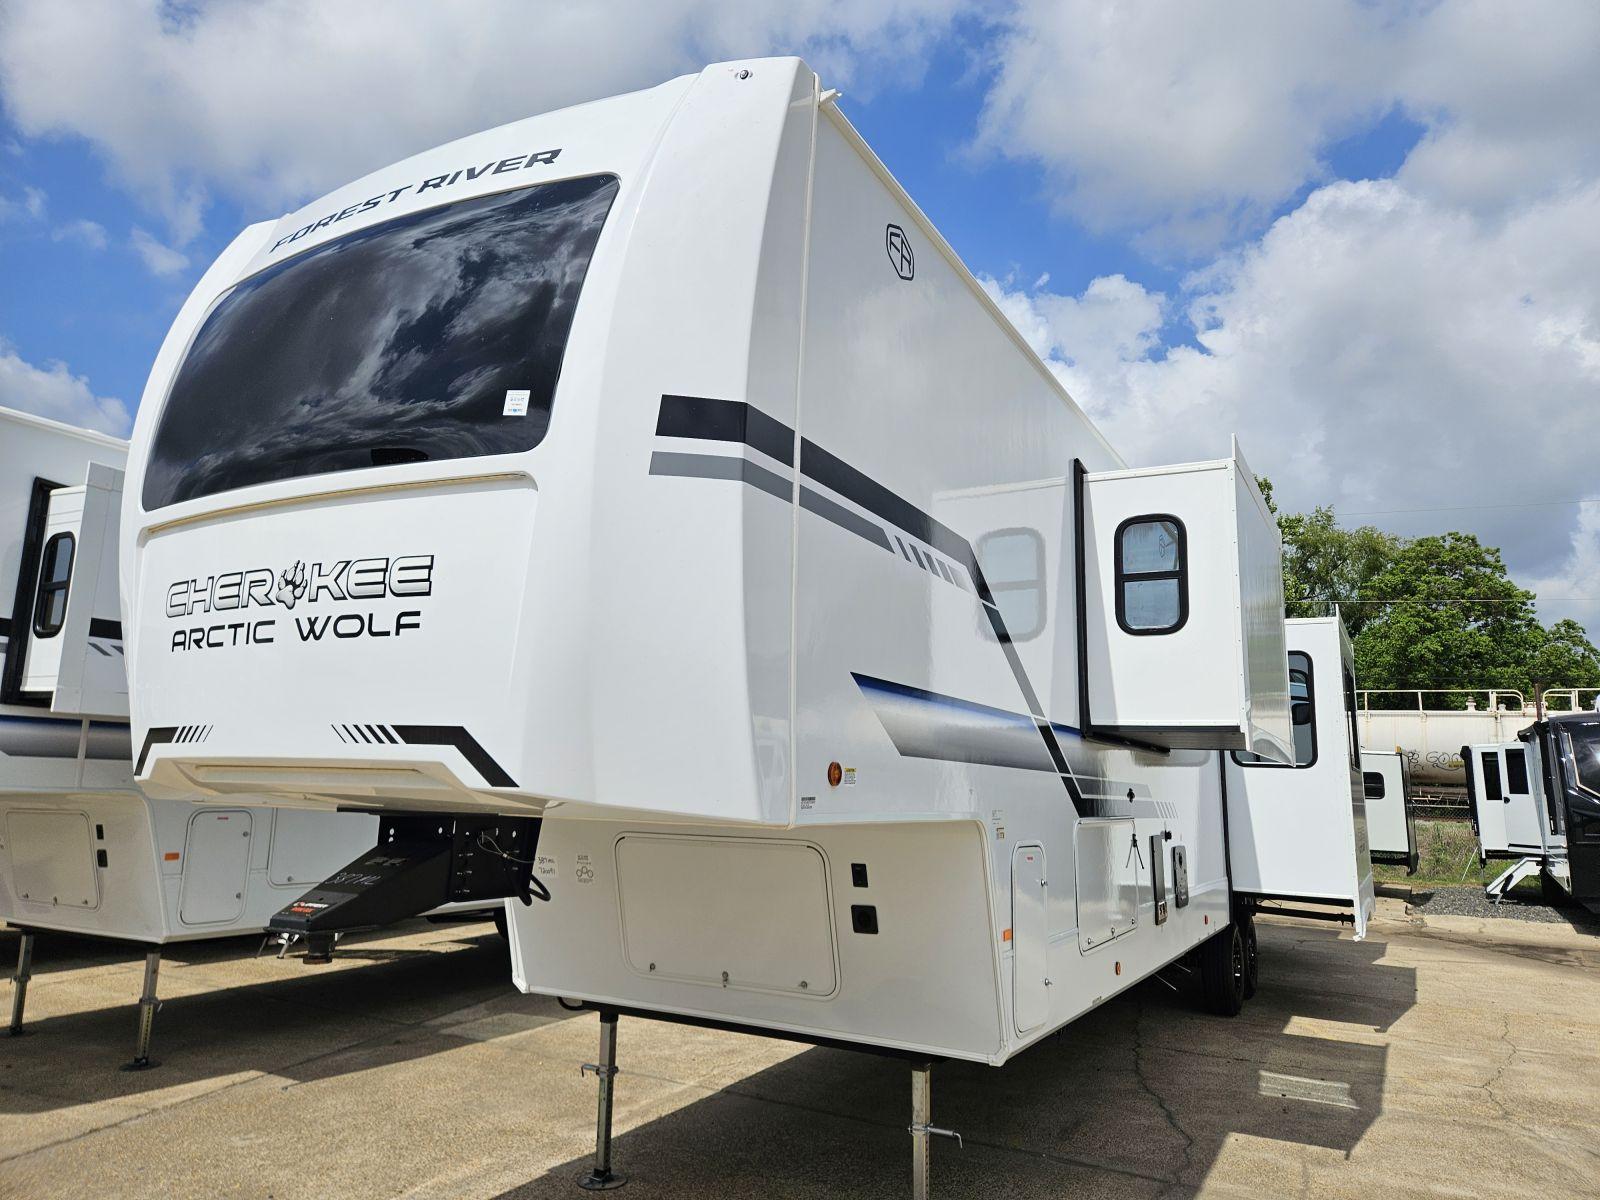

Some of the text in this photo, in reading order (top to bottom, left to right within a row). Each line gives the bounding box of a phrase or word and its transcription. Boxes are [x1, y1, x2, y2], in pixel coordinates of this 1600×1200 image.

[269, 148, 563, 254] FOREST RIVER
[172, 611, 421, 652] ARCTIC WOLF
